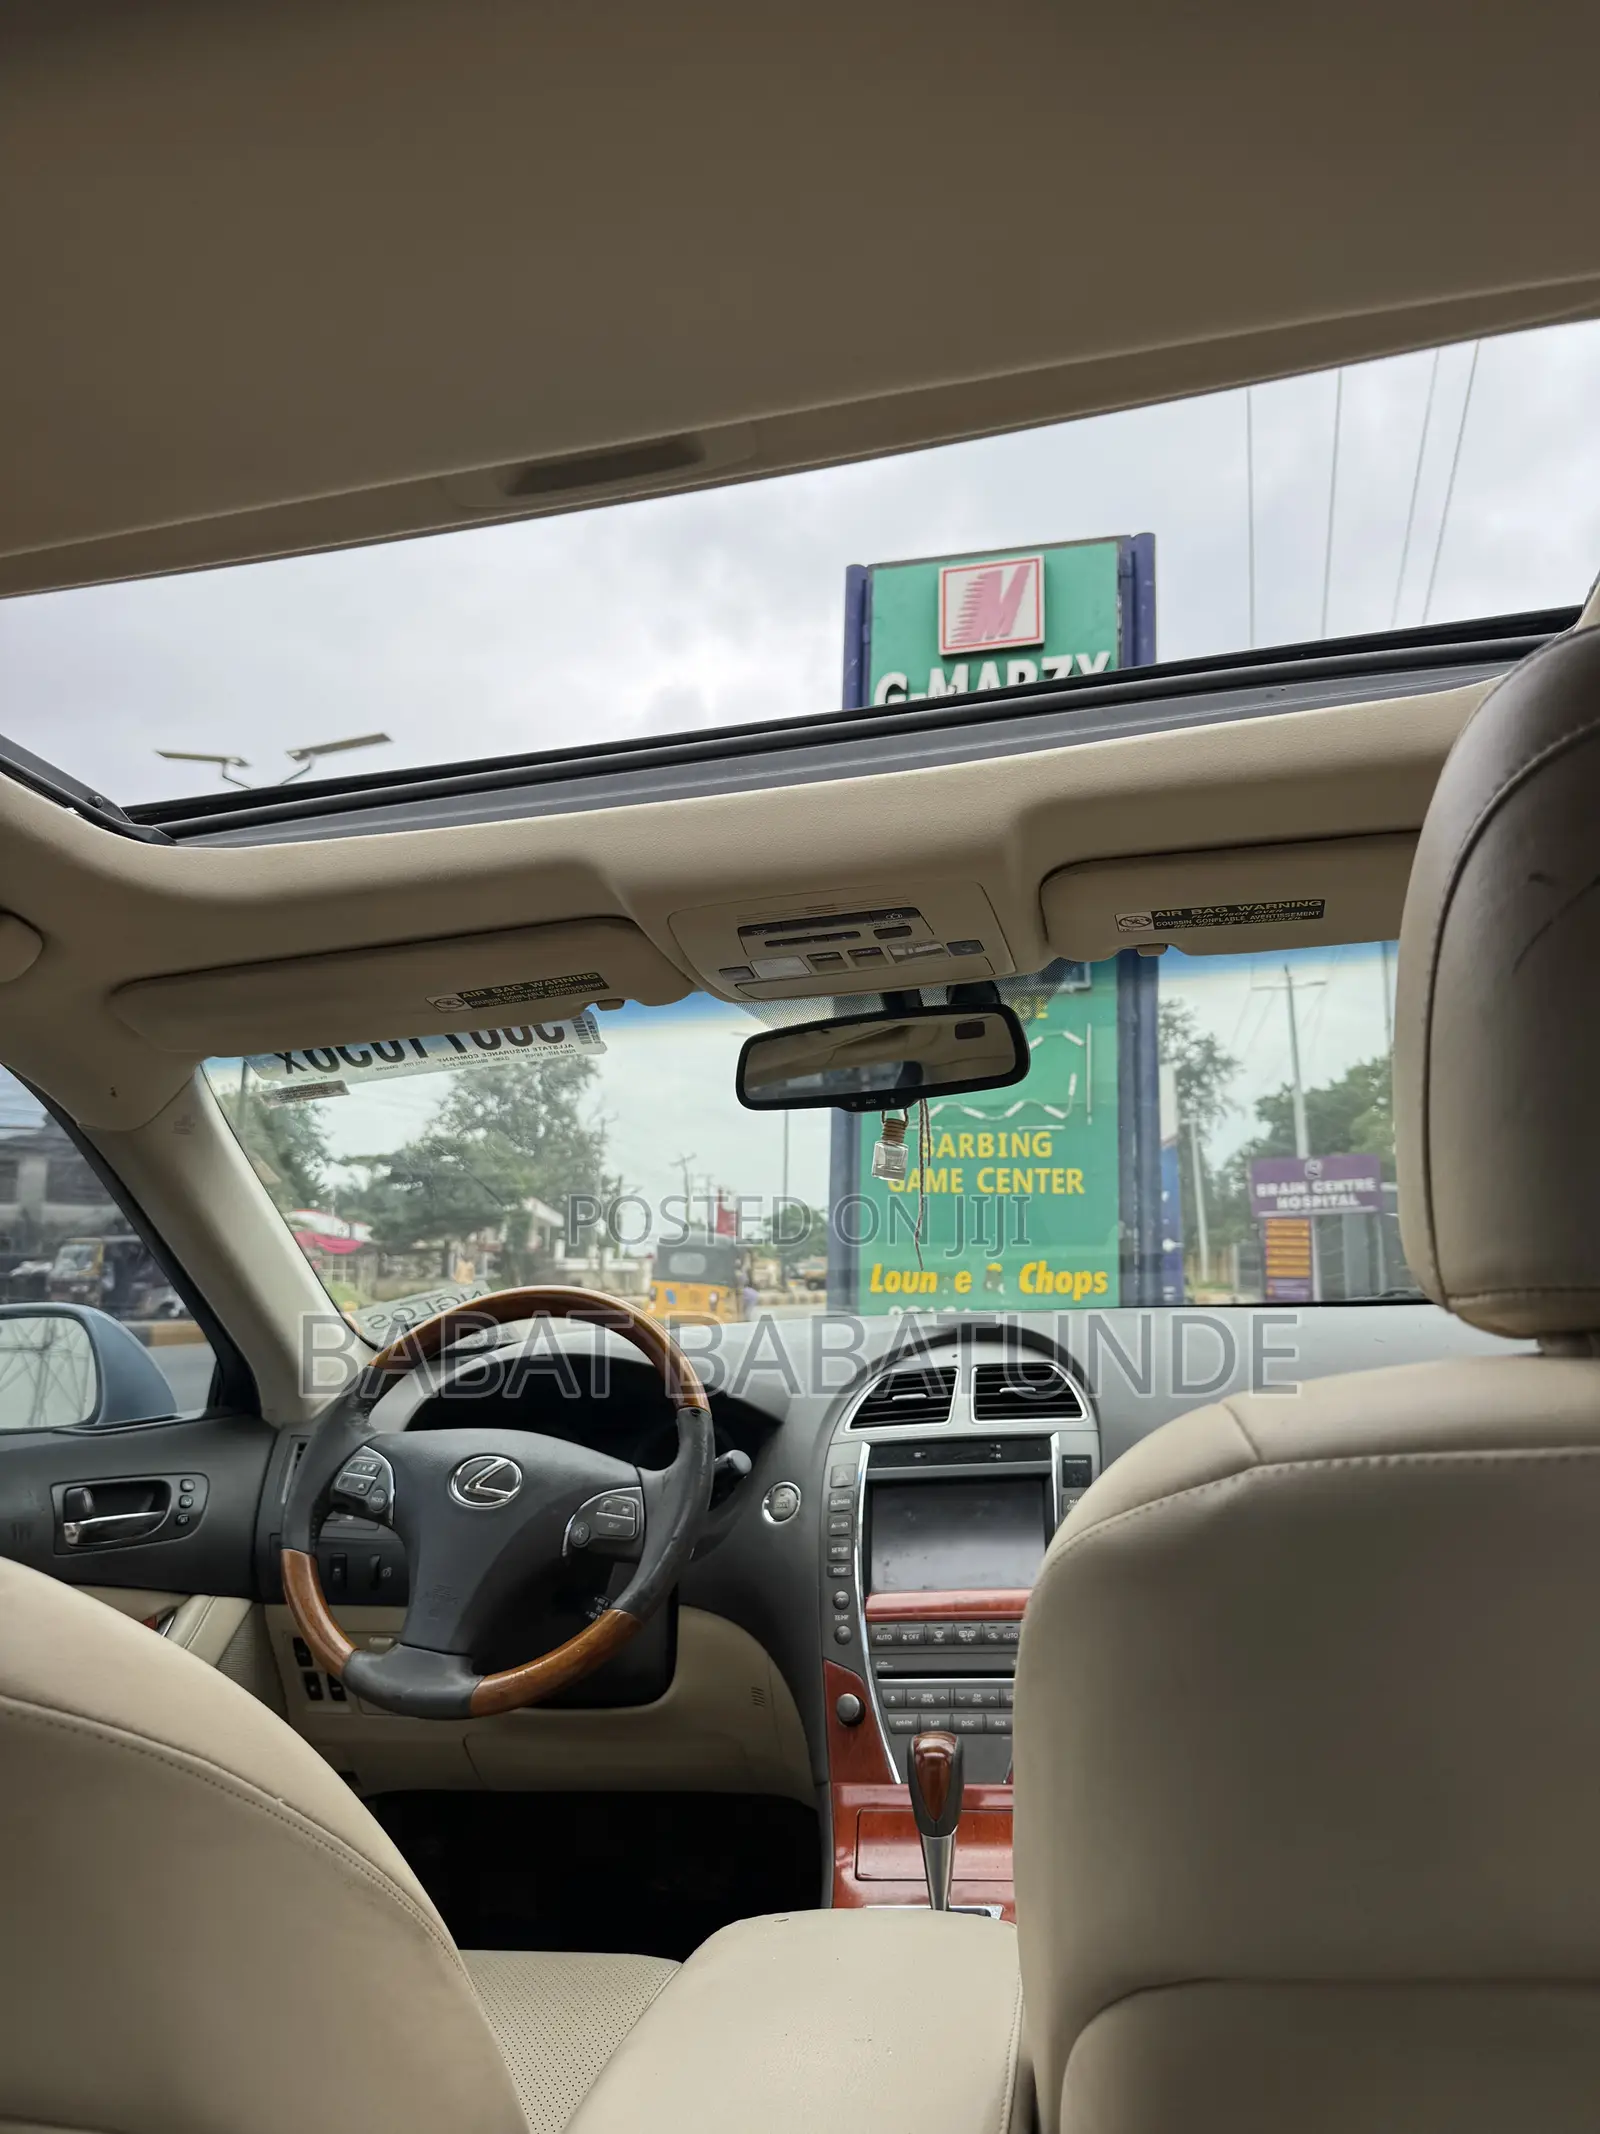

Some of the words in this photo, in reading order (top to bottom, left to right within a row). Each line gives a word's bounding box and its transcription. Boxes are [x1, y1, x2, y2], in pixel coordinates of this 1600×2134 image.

[1155, 910, 1183, 919] AIR
[1191, 906, 1228, 916] BAG
[1237, 899, 1323, 913] WARNING
[462, 989, 488, 999] AIR
[530, 972, 599, 988] WARNING
[976, 1167, 1086, 1194] CENTER
[1276, 1193, 1362, 1210] HOSPITAL
[869, 1263, 973, 1295] Loune
[1018, 1259, 1109, 1301] Chops
[908, 1633, 920, 1641] OFF
